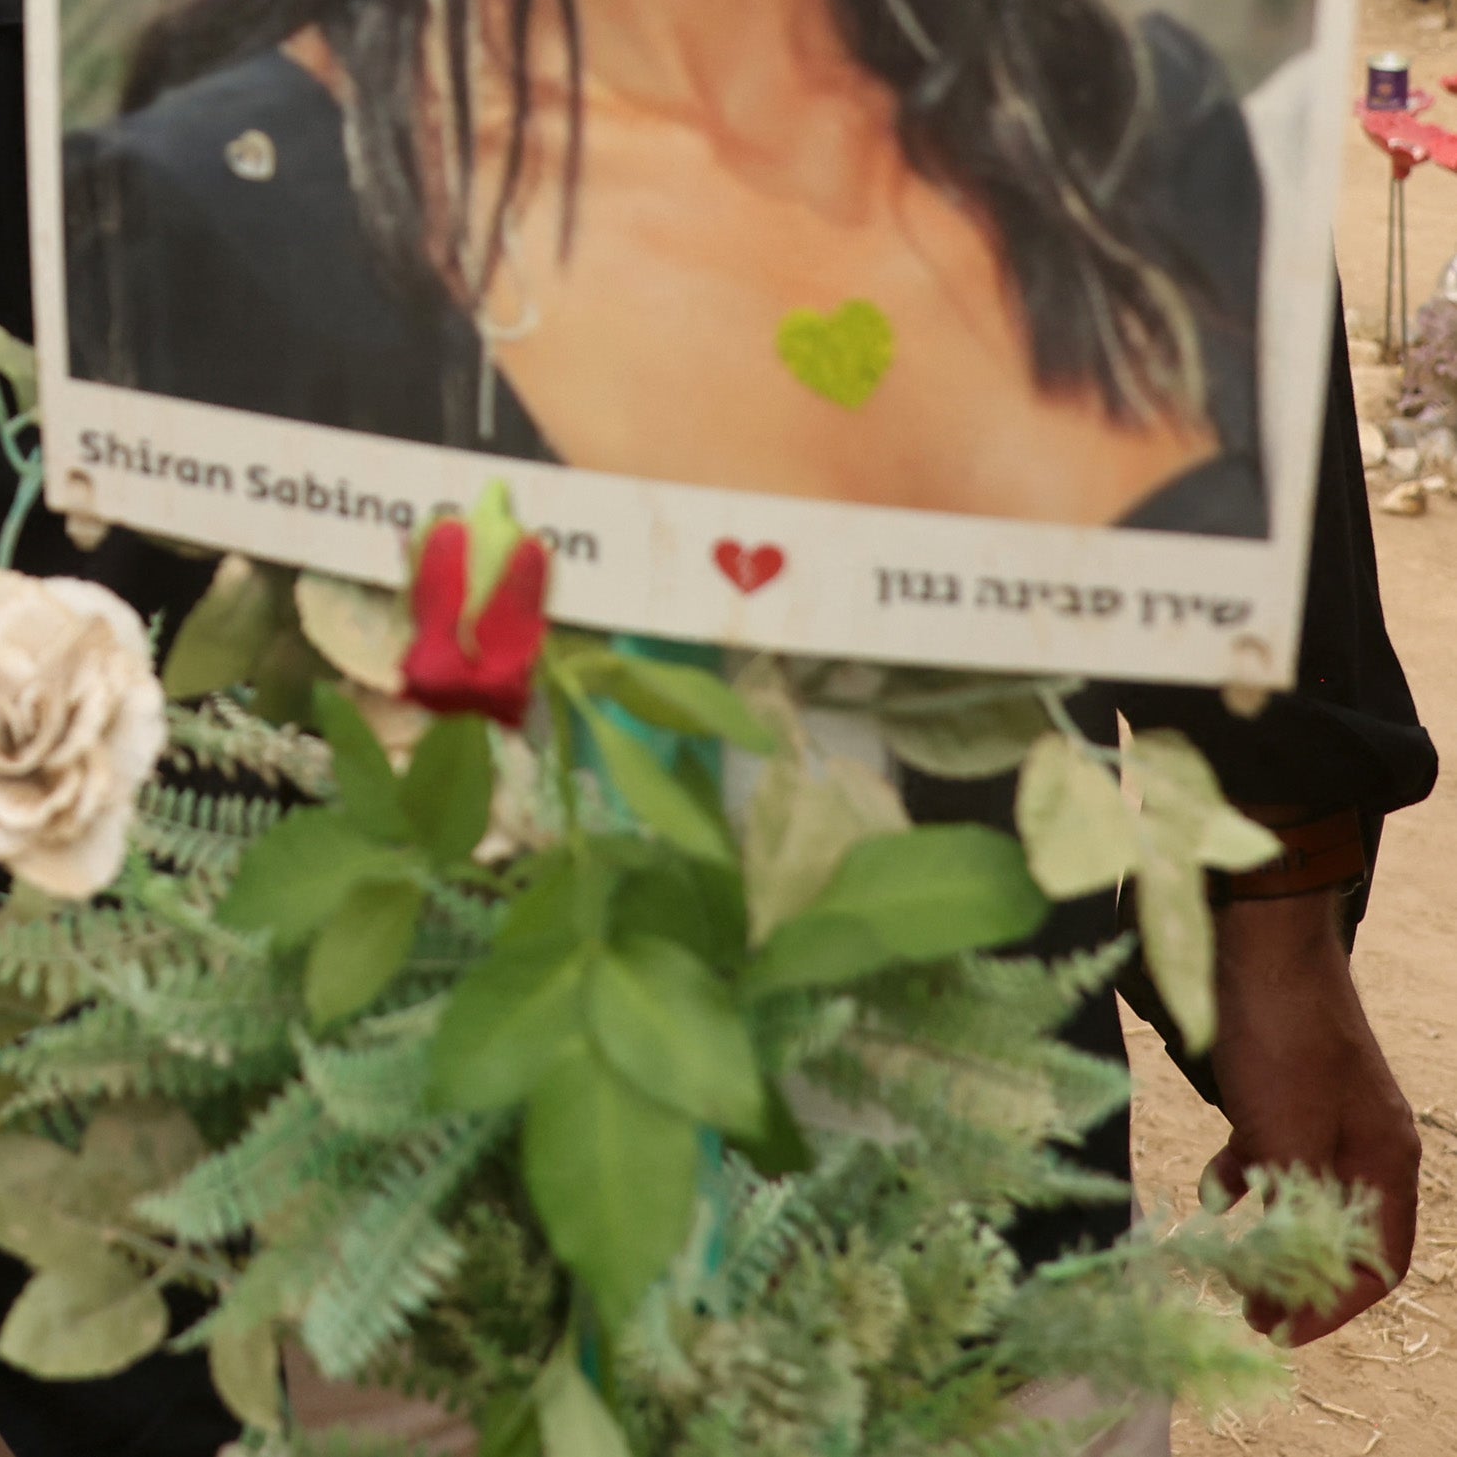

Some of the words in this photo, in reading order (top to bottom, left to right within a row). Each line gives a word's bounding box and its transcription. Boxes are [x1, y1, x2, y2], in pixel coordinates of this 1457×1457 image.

[78, 430, 234, 492] Shiran
[245, 463, 416, 530] Sabina
[1140, 587, 1253, 625] שירן
